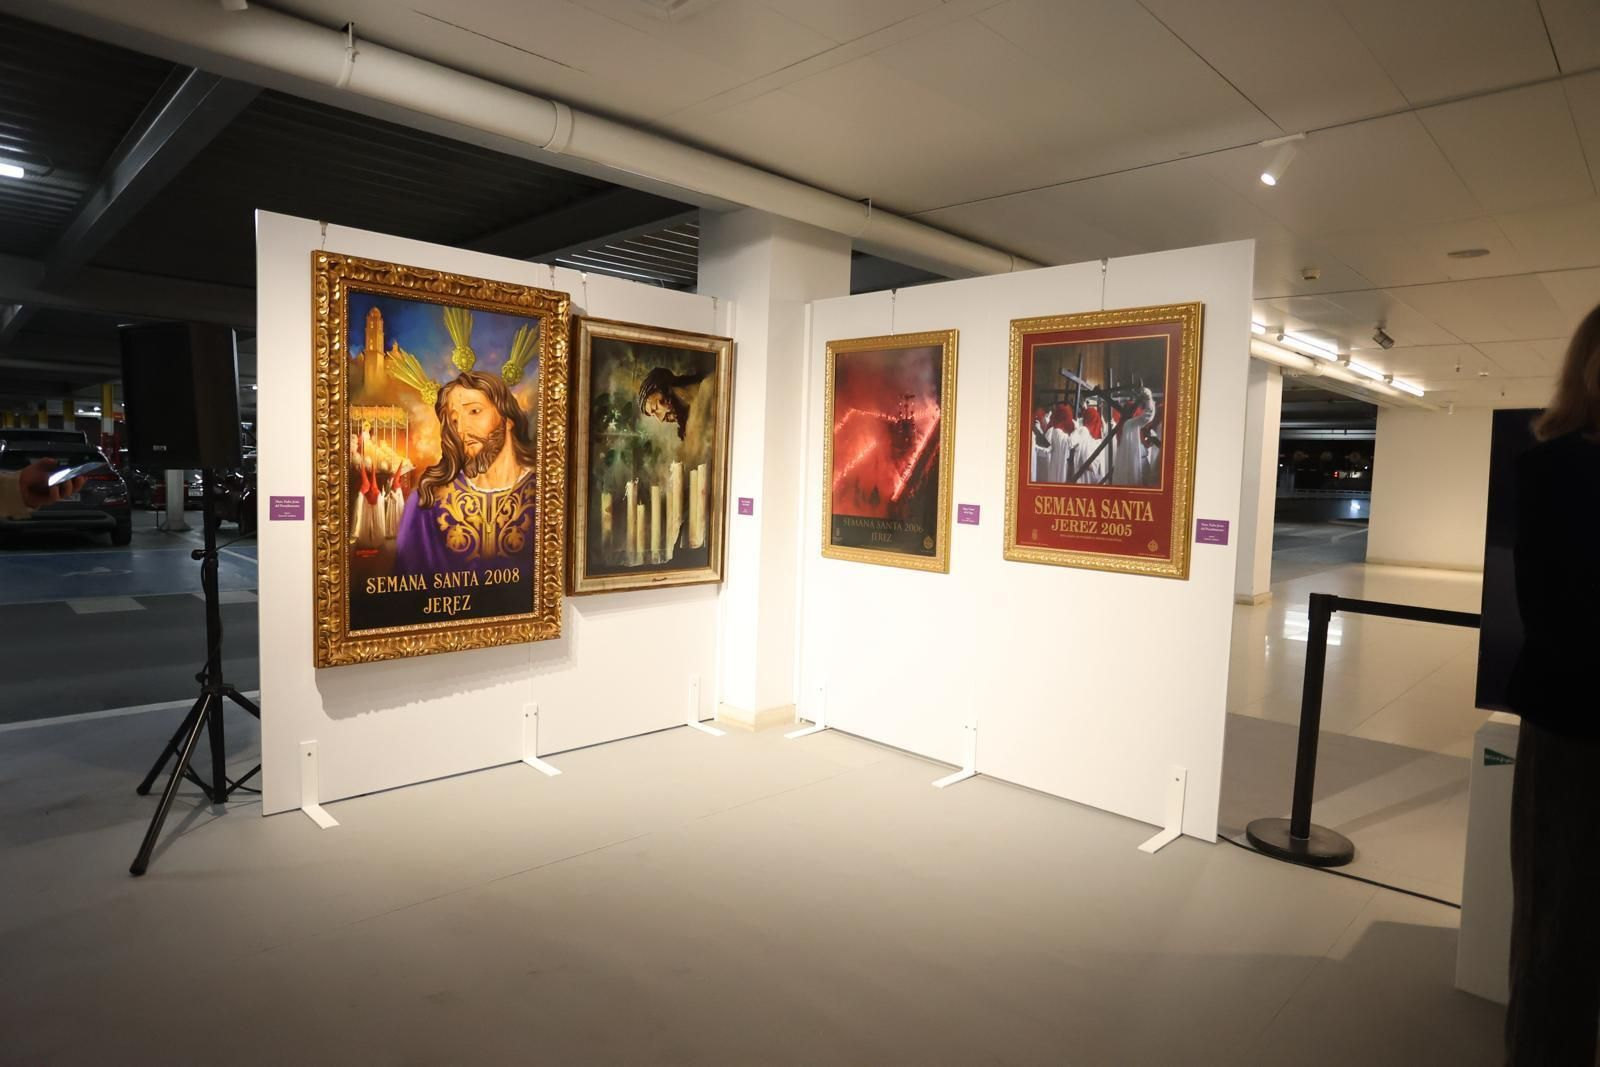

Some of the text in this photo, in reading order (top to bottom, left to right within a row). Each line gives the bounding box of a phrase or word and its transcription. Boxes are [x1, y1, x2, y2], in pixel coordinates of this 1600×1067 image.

[1034, 496, 1154, 521] SEMANA SANTA
[1051, 519, 1132, 536] JEREZ 2005
[366, 568, 520, 594] SEMANA SANTA 2008
[423, 594, 472, 616] JEREZ
